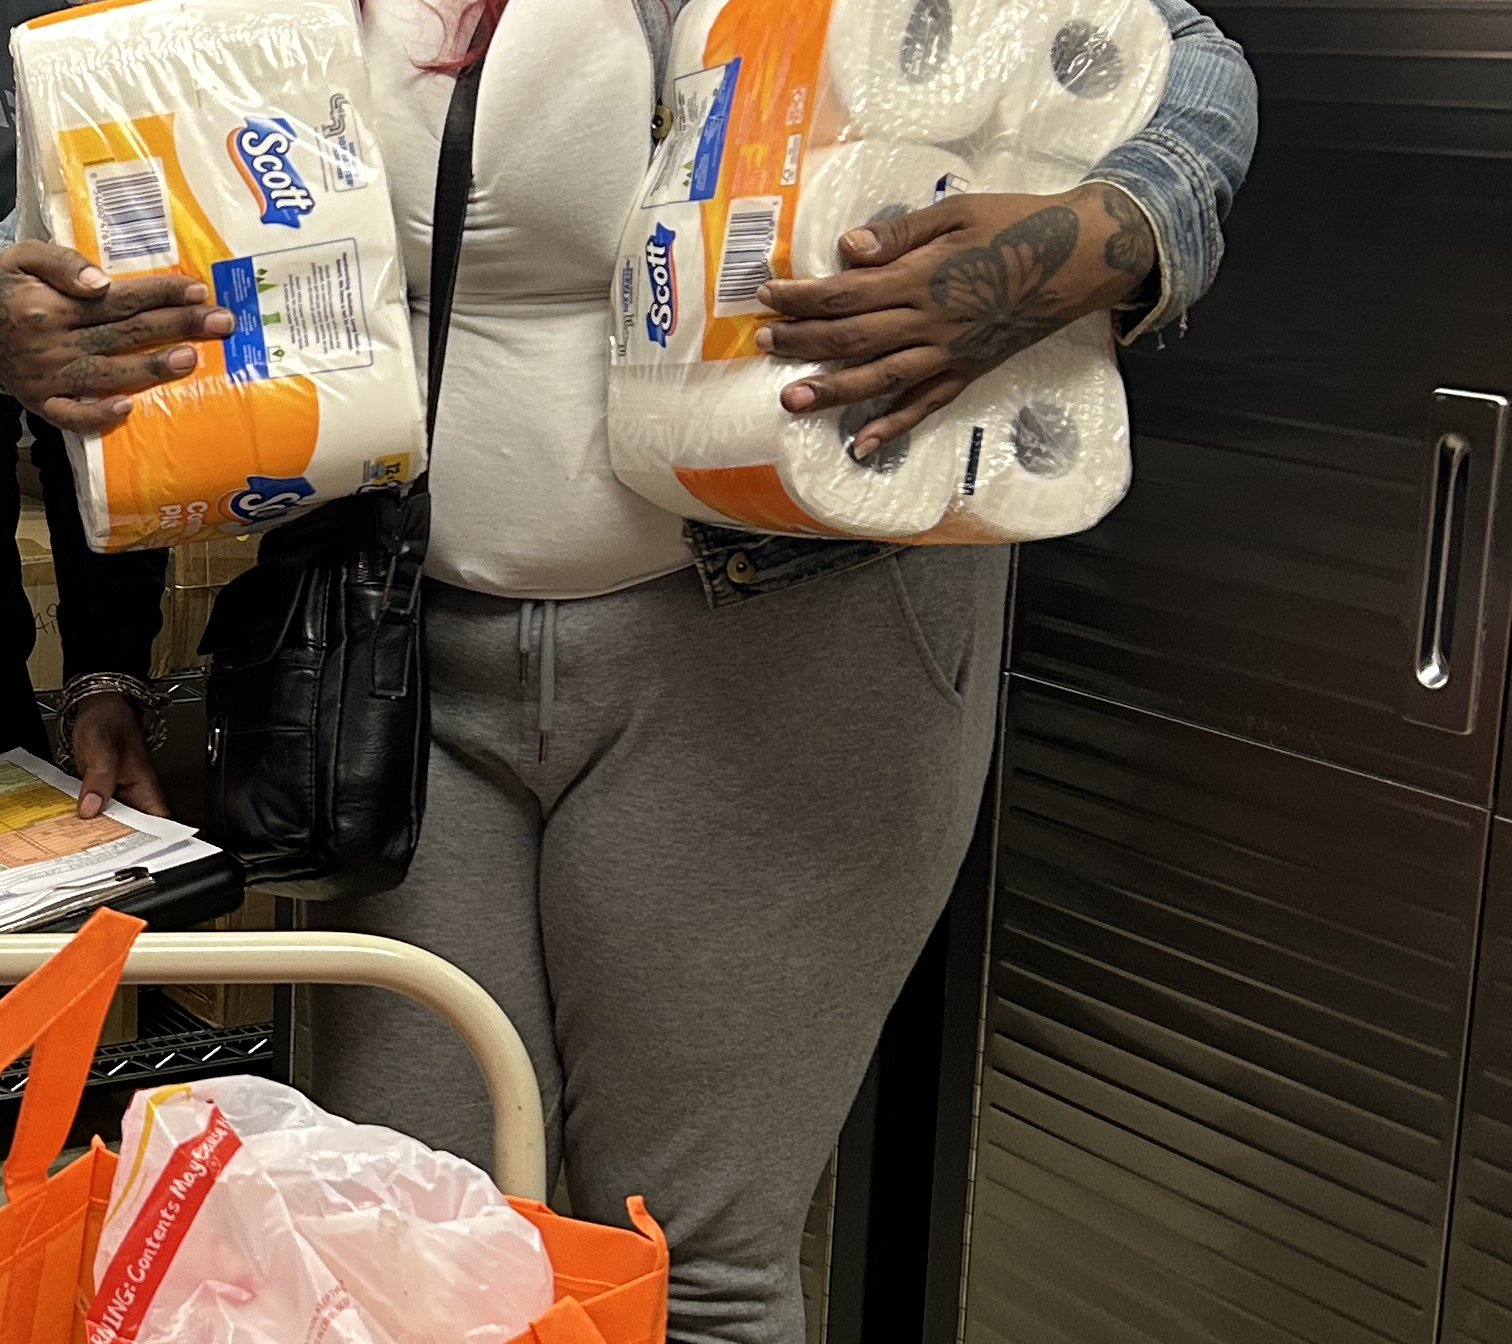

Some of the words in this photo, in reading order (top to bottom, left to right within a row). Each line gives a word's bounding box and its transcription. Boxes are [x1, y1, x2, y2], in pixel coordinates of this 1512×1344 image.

[241, 130, 315, 211] Scott
[646, 240, 673, 333] Scott
[127, 1198, 181, 1284] Contents
[169, 1160, 208, 1201] May
